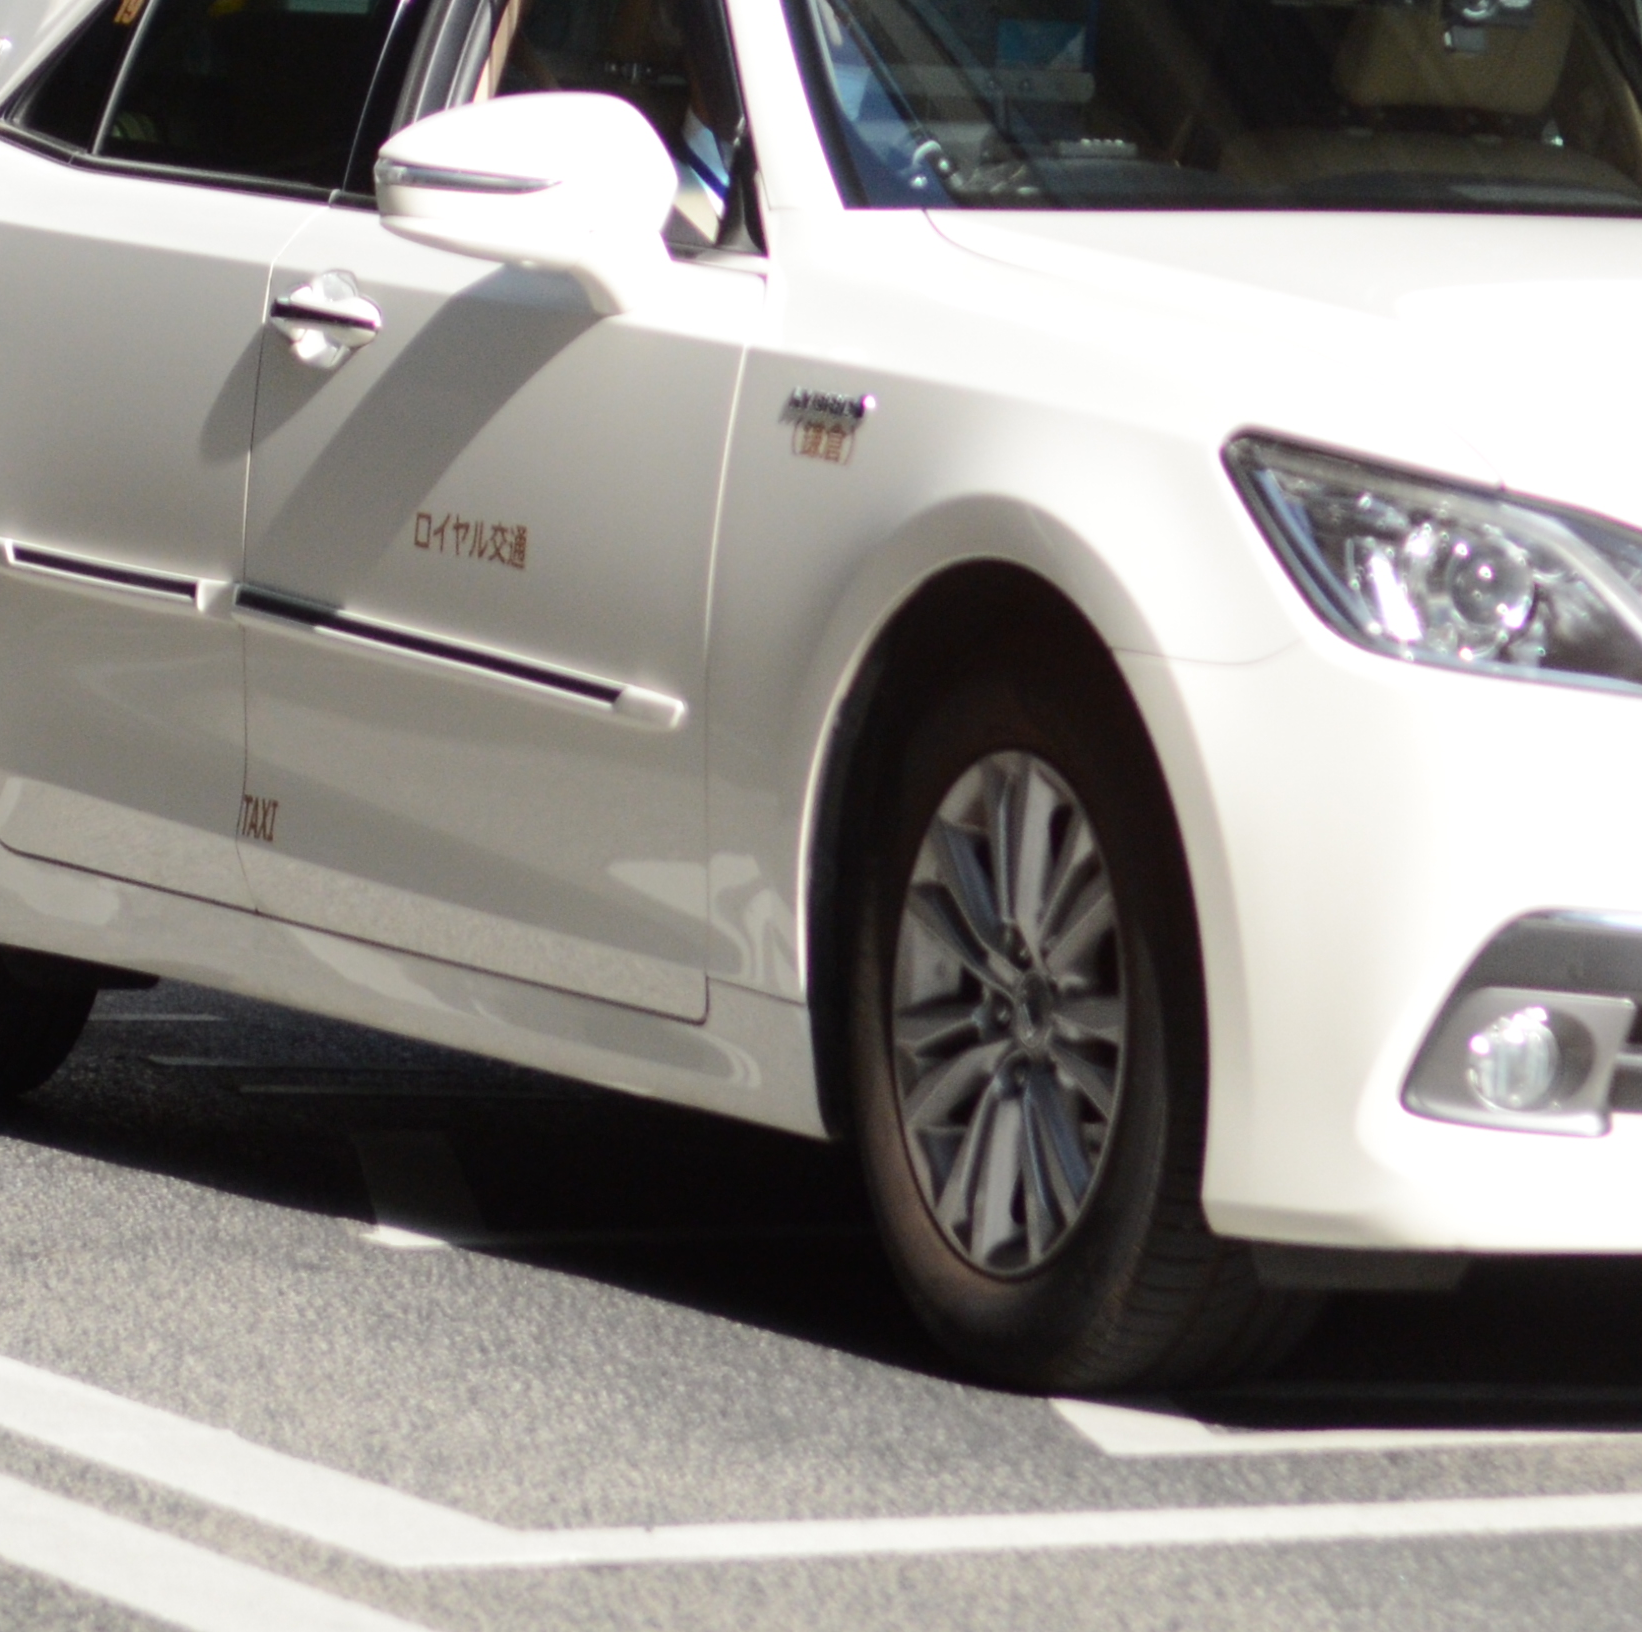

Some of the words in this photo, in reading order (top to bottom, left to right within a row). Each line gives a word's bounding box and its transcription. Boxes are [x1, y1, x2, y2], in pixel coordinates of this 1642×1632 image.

[413, 511, 529, 570] ロイヤル交通
[240, 793, 279, 843] TAXI
